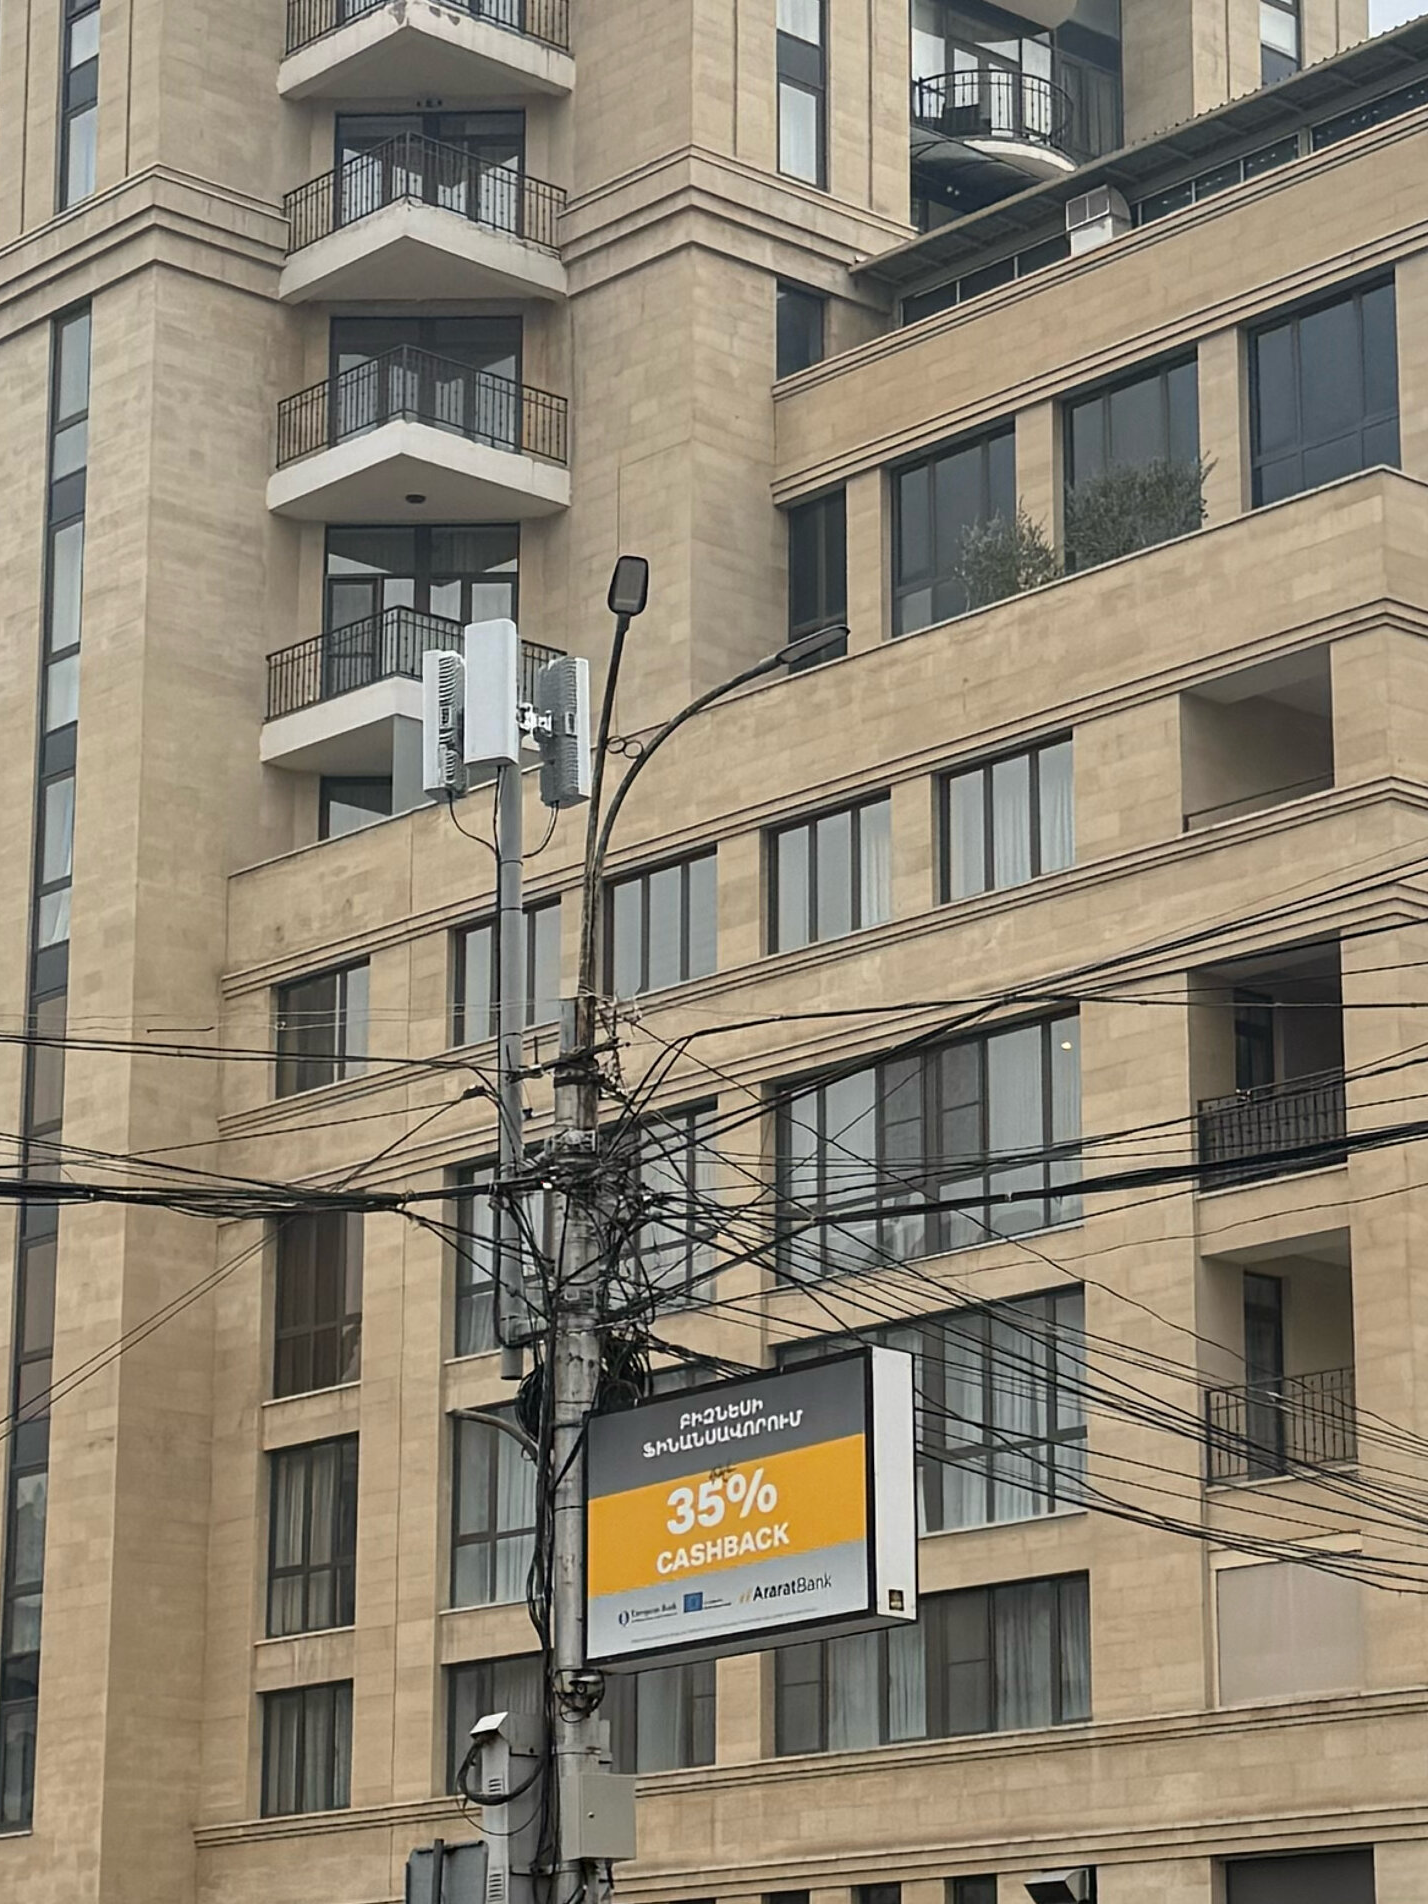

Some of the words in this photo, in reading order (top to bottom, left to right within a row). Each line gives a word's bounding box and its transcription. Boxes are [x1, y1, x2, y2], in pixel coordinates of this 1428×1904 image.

[642, 1409, 804, 1459] ՖԻՆԱՆՍԱՎՈՐՈՒՄ
[680, 1398, 764, 1430] ԲԻԶՆԵՍԻ
[665, 1467, 778, 1536] 35%
[655, 1522, 790, 1574] CASHBACK
[752, 1572, 832, 1602] AraratBank
